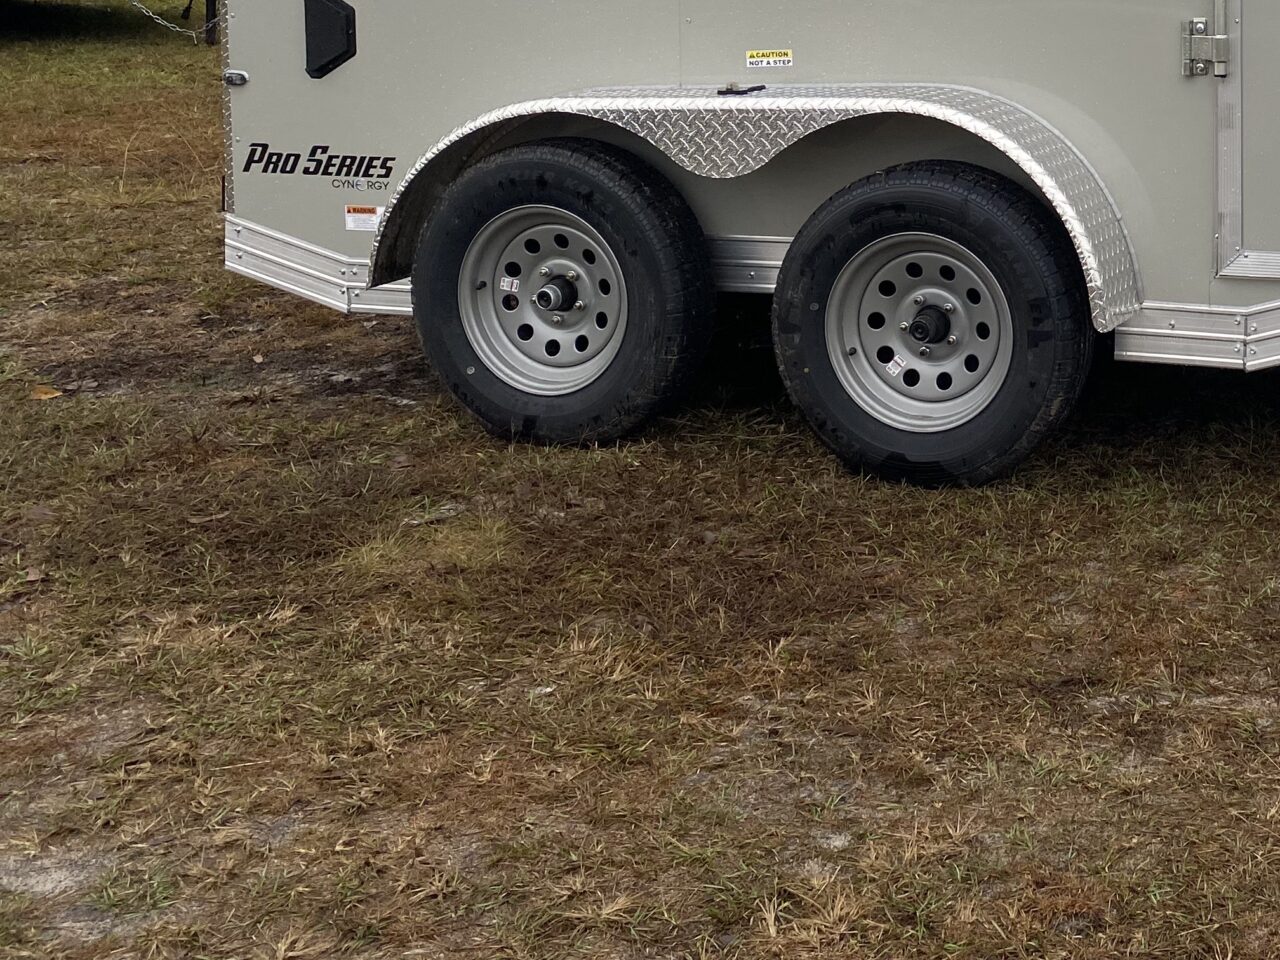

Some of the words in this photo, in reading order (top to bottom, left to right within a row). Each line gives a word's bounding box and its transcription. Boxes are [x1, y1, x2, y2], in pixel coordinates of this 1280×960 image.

[242, 142, 301, 174] PRO
[302, 145, 396, 179] SERIES
[332, 178, 390, 191] CYNERGY
